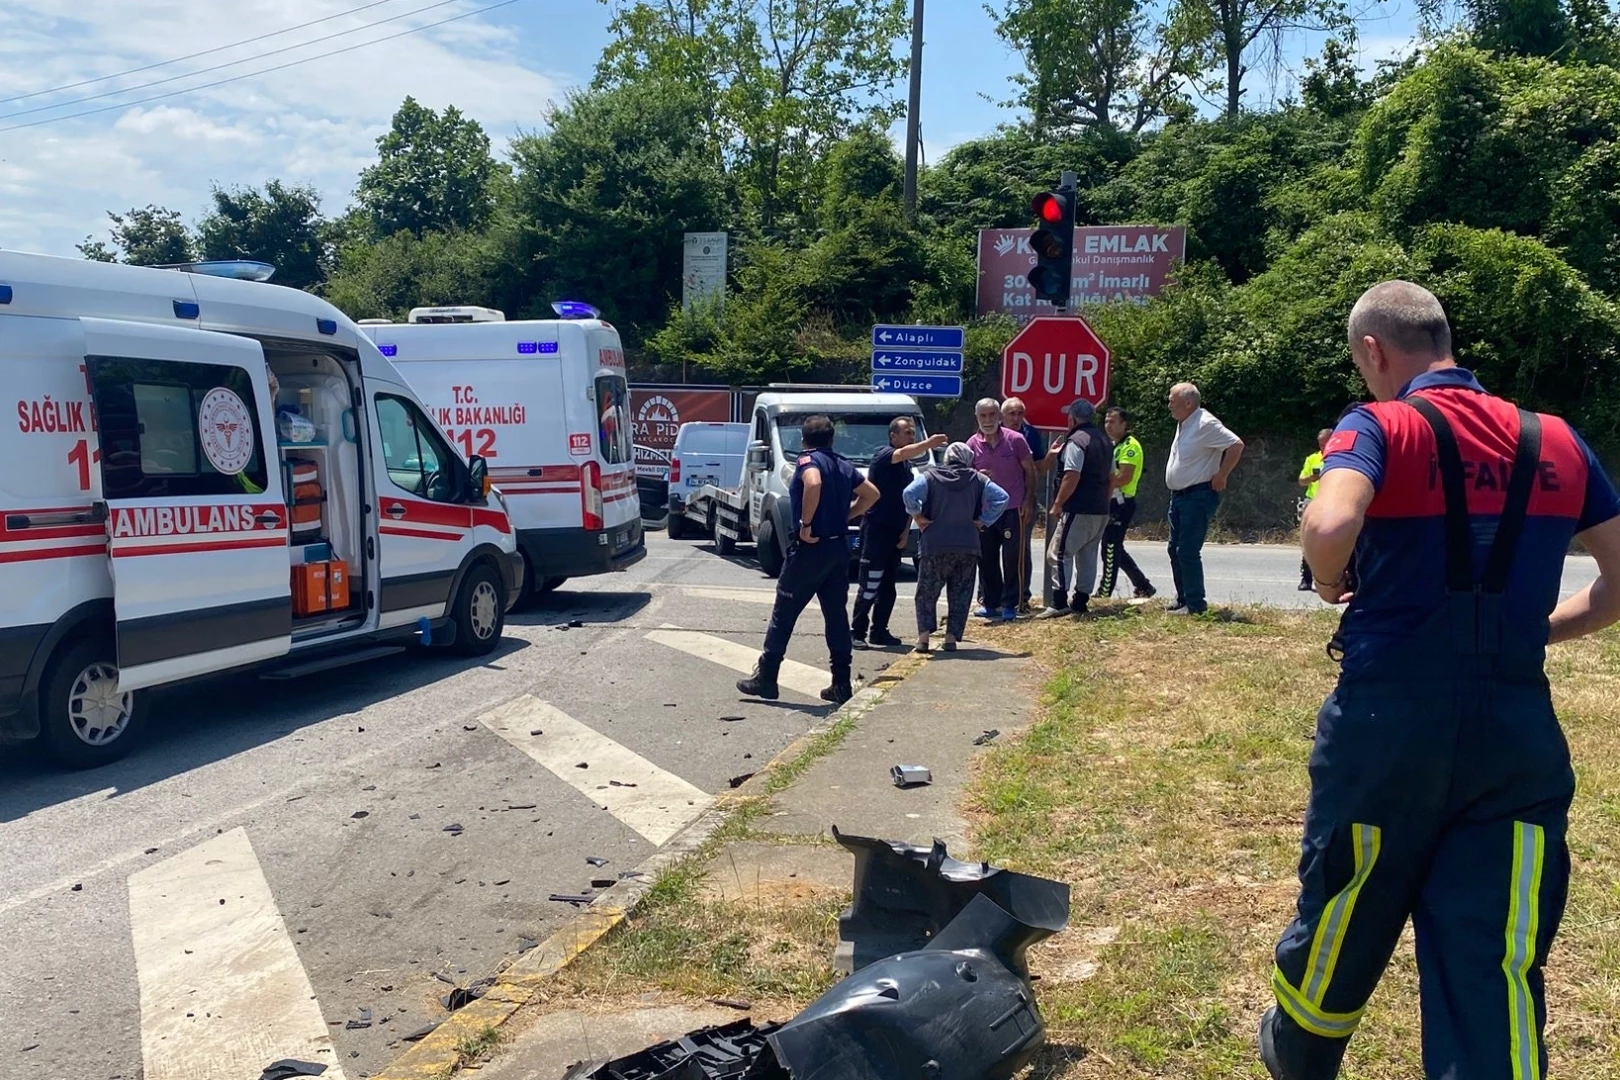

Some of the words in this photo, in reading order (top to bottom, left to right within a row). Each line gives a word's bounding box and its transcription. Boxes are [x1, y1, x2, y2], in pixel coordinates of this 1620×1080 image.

[1084, 233, 1169, 254] EMLAK
[1093, 254, 1155, 266] Danışmanlık
[1099, 270, 1150, 288] İmarlı
[1003, 292, 1032, 306] Kat
[895, 332, 934, 344] Alaplı
[894, 356, 957, 368] Zonguldak
[1011, 351, 1099, 396] DUR
[893, 380, 933, 390] Düzce
[452, 385, 478, 404] T.C.
[17, 394, 86, 433] SAĞLIK
[456, 402, 526, 426] BAKANLIĞI
[571, 435, 589, 447] 112
[114, 504, 255, 537] AMBULANS
